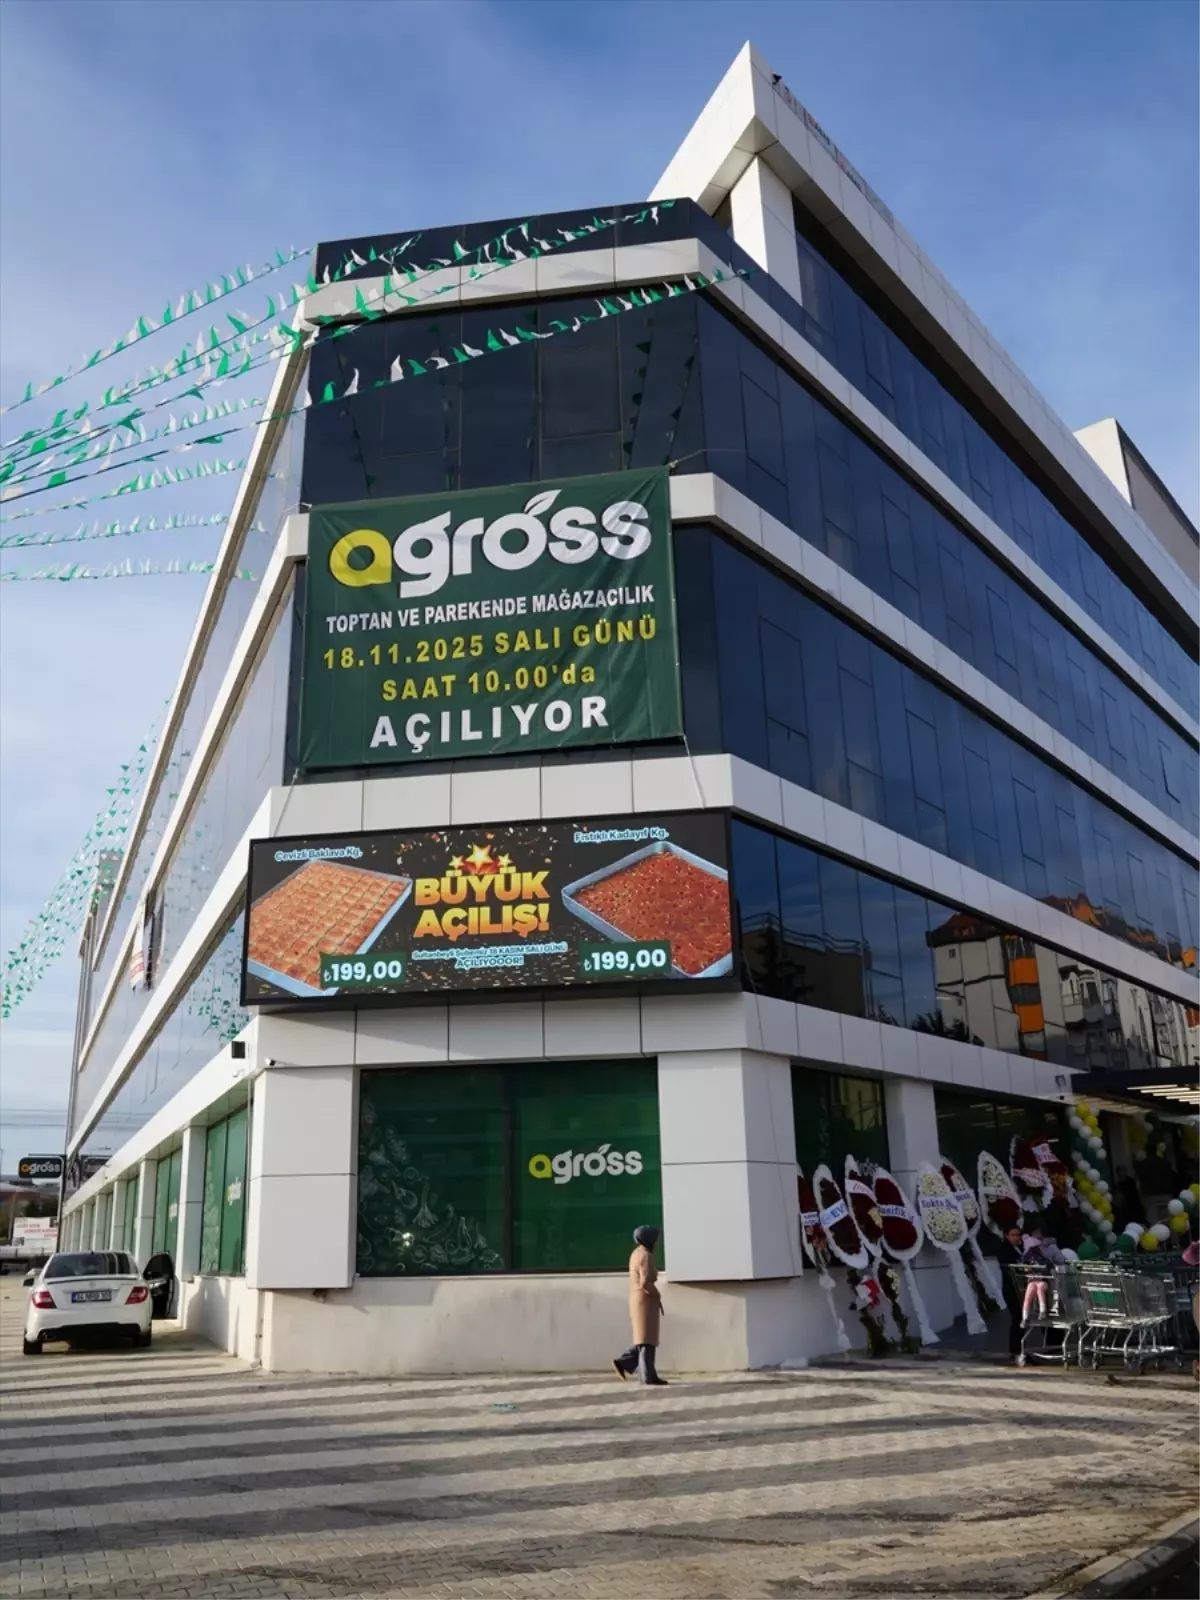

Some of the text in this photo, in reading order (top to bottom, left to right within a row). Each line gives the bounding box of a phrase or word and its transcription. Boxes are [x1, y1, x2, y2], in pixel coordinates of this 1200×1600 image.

[329, 490, 652, 598] agross
[326, 584, 654, 634] TOPTAN VE PAREKENDE MAĞAZACILIK
[323, 614, 656, 669] 18.11.2025 SALI GÜNÜ
[382, 663, 596, 701] SAAT 10.00'da
[369, 695, 608, 753] AÇILIYOR
[308, 848, 345, 860] Baklava
[415, 867, 550, 905] BÜYÜK
[412, 904, 550, 941] AÇILIŞ!
[20, 1161, 61, 1174] agross
[528, 1143, 643, 1184] agross
